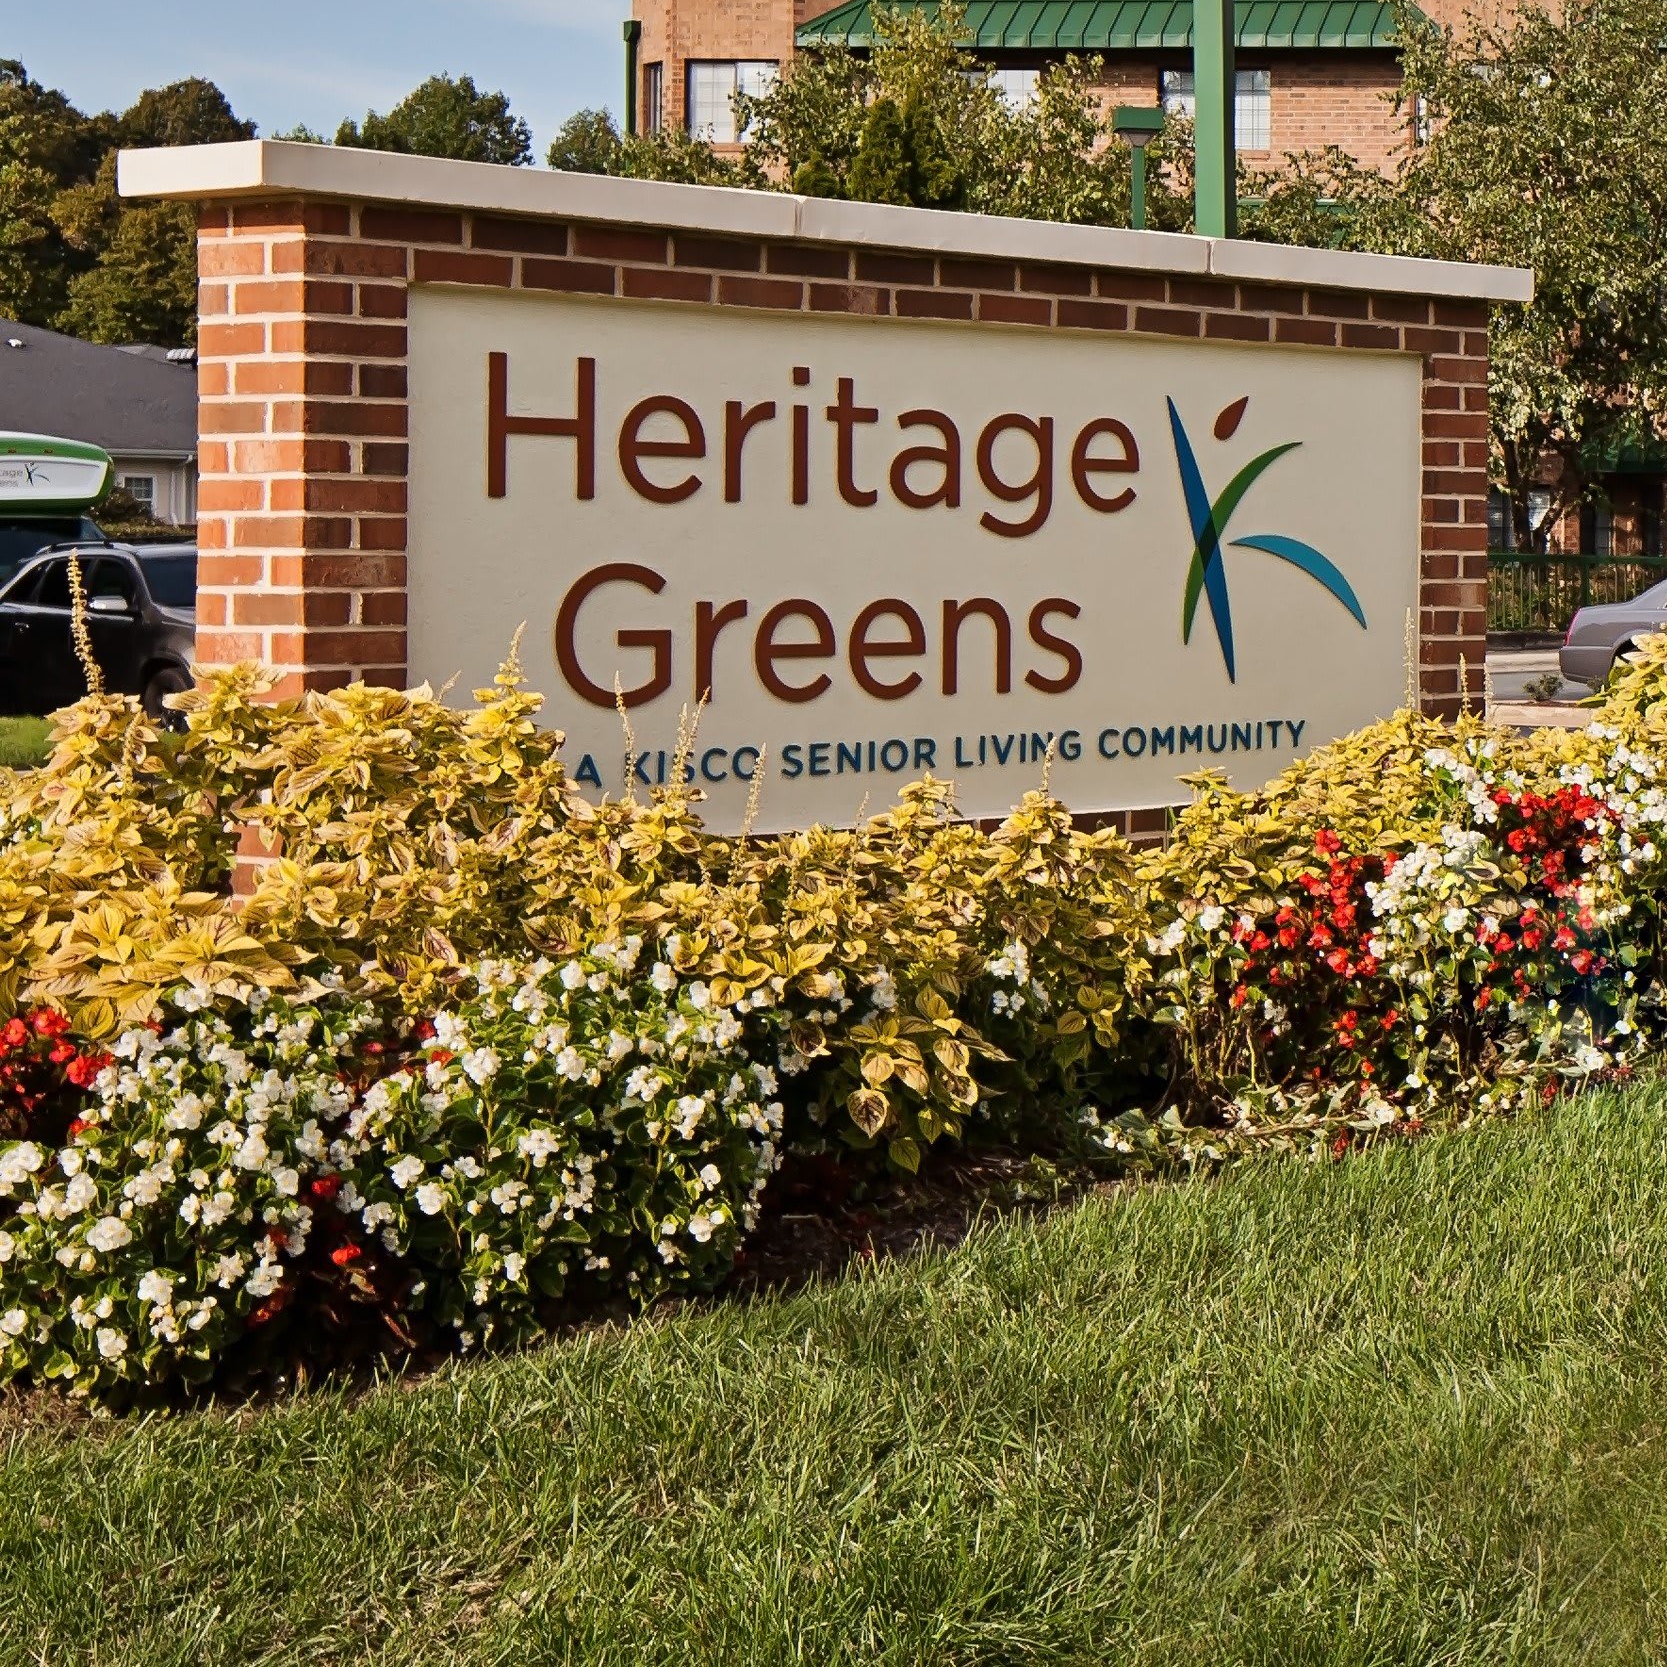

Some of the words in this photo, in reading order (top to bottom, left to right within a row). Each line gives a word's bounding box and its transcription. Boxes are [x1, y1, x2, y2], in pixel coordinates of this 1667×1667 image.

[486, 351, 1140, 537] Heritage
[554, 562, 1083, 709] Greens
[574, 753, 602, 789] A
[781, 737, 937, 779] SENIOR
[955, 729, 1082, 767] LIVING
[1099, 719, 1306, 759] COMMUNITY
